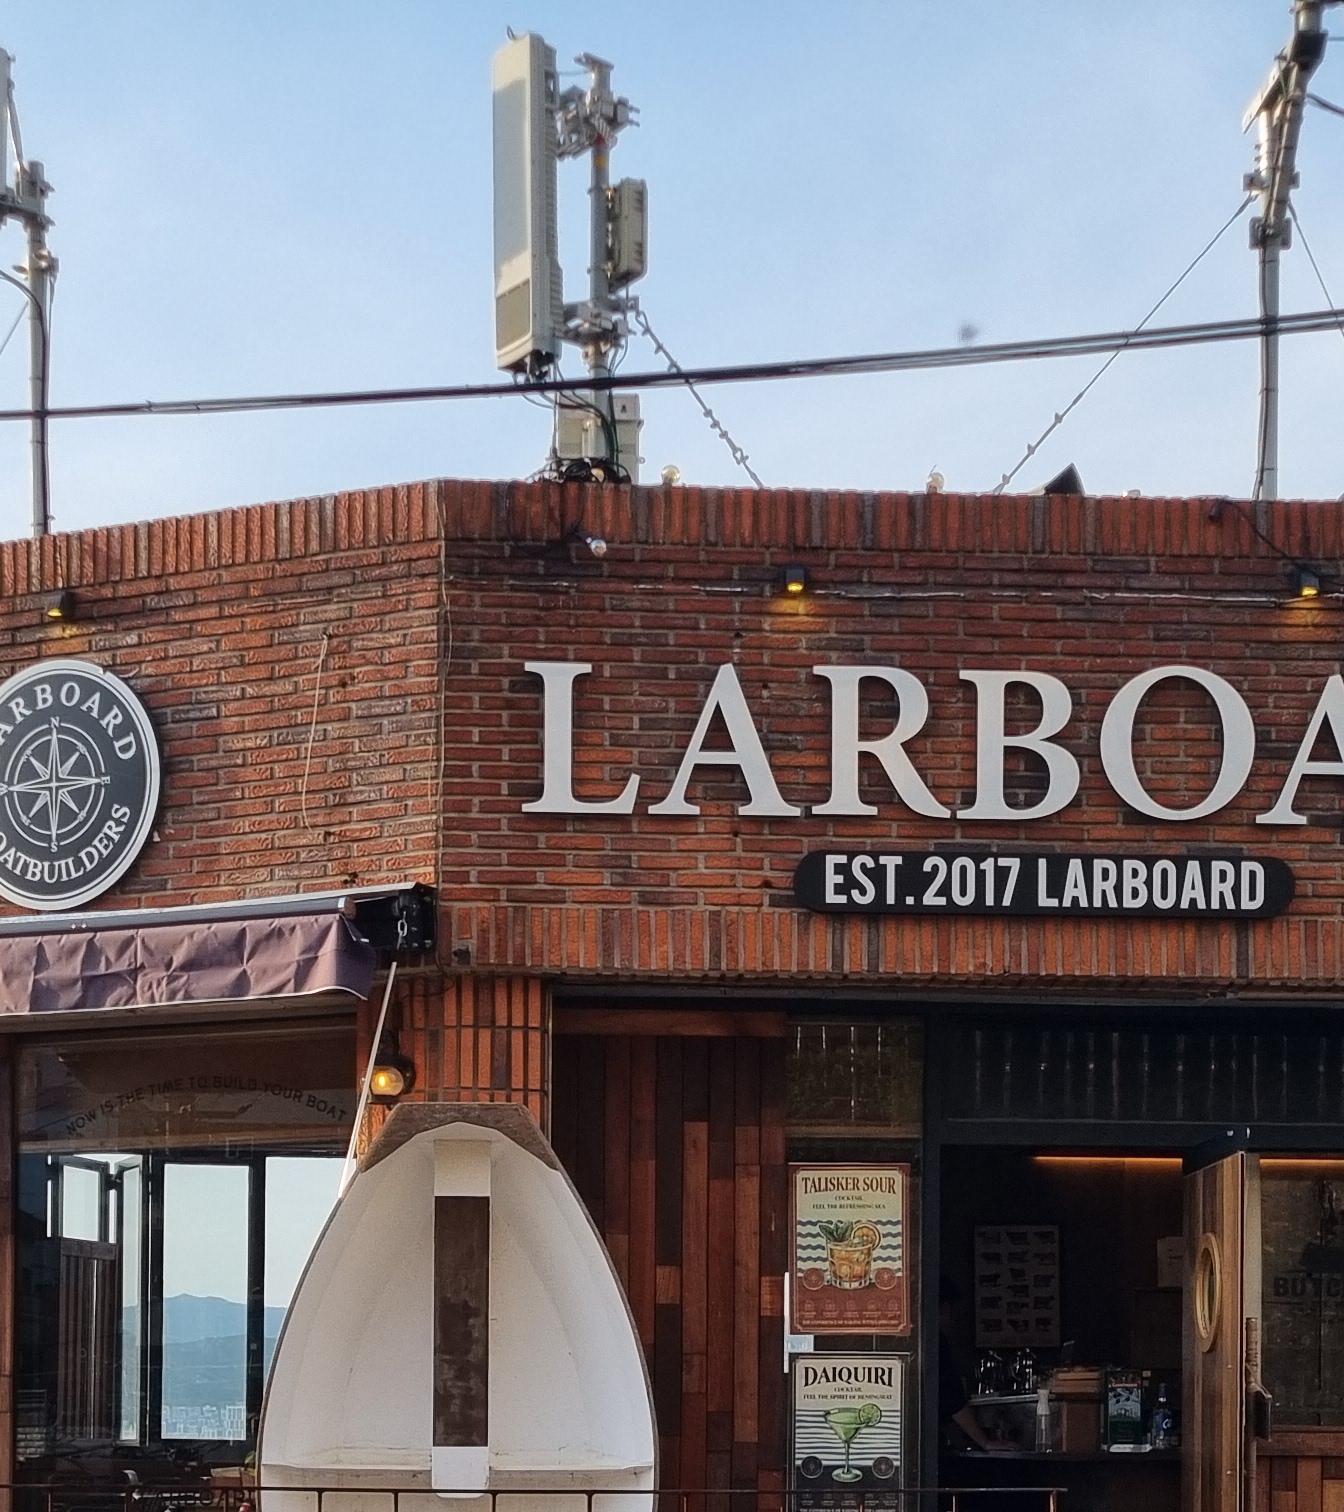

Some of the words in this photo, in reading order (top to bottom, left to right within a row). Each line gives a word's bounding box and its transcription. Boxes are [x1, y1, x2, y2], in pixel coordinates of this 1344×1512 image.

[825, 854, 1021, 907] EST.2017
[1038, 858, 1266, 910] LARBOARD
[65, 1109, 97, 1135] NOW
[100, 1100, 114, 1114] IS
[117, 1087, 145, 1106] THE
[148, 1078, 183, 1095] TIME
[188, 1076, 208, 1089] TO
[212, 1076, 258, 1091] BUILD
[262, 1081, 303, 1104] YOUR
[305, 1094, 347, 1121] BOAT
[801, 1176, 861, 1194] TALISKER
[862, 1176, 896, 1195] SOUR
[803, 1366, 893, 1388] DAIQUIRI
